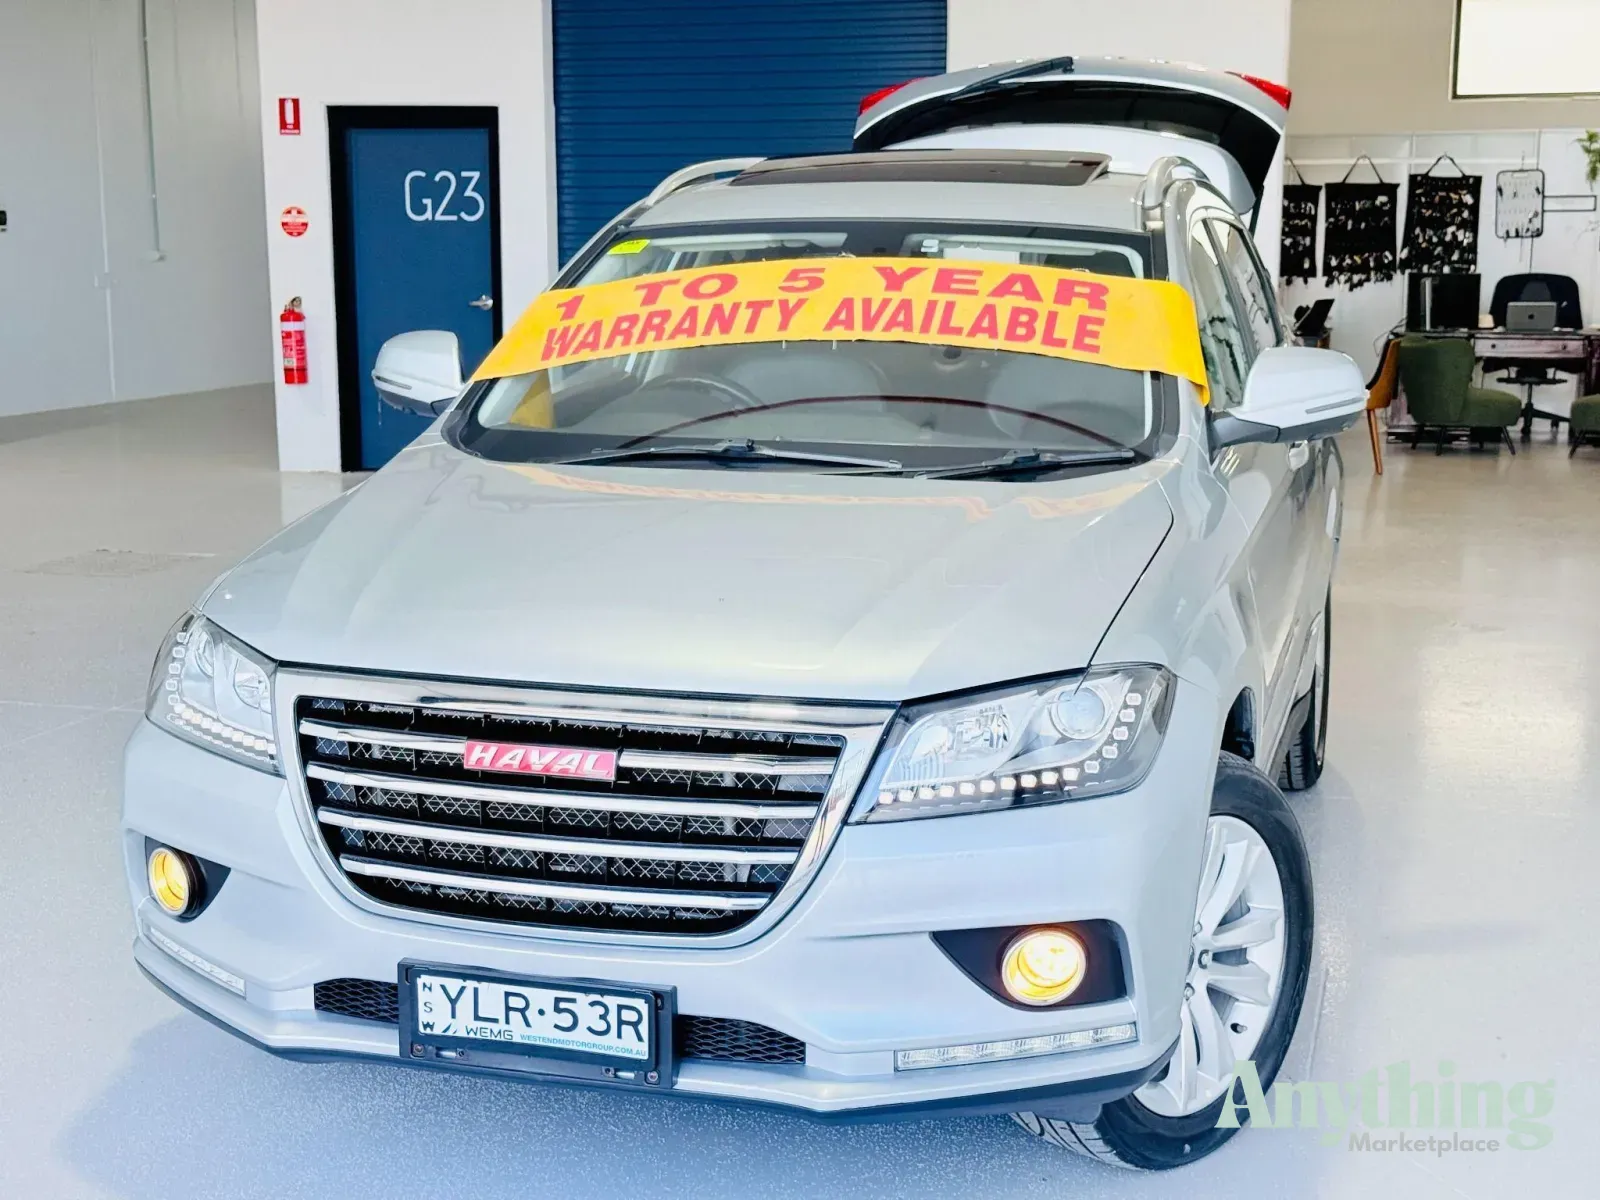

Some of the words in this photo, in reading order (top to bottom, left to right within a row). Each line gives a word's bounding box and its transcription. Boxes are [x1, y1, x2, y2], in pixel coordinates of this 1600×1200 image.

[404, 170, 485, 222] G23
[555, 294, 585, 321] 1
[633, 273, 738, 307] TO
[778, 267, 826, 293] 5
[872, 266, 1110, 311] YEAR
[541, 298, 809, 361] WARRANTY
[823, 297, 1105, 354] AVAILABLE
[467, 744, 610, 777] HAVAL
[465, 1025, 514, 1041] WEMG
[520, 1034, 646, 1057] WESTENDMOTORGROUP.COM.AU
